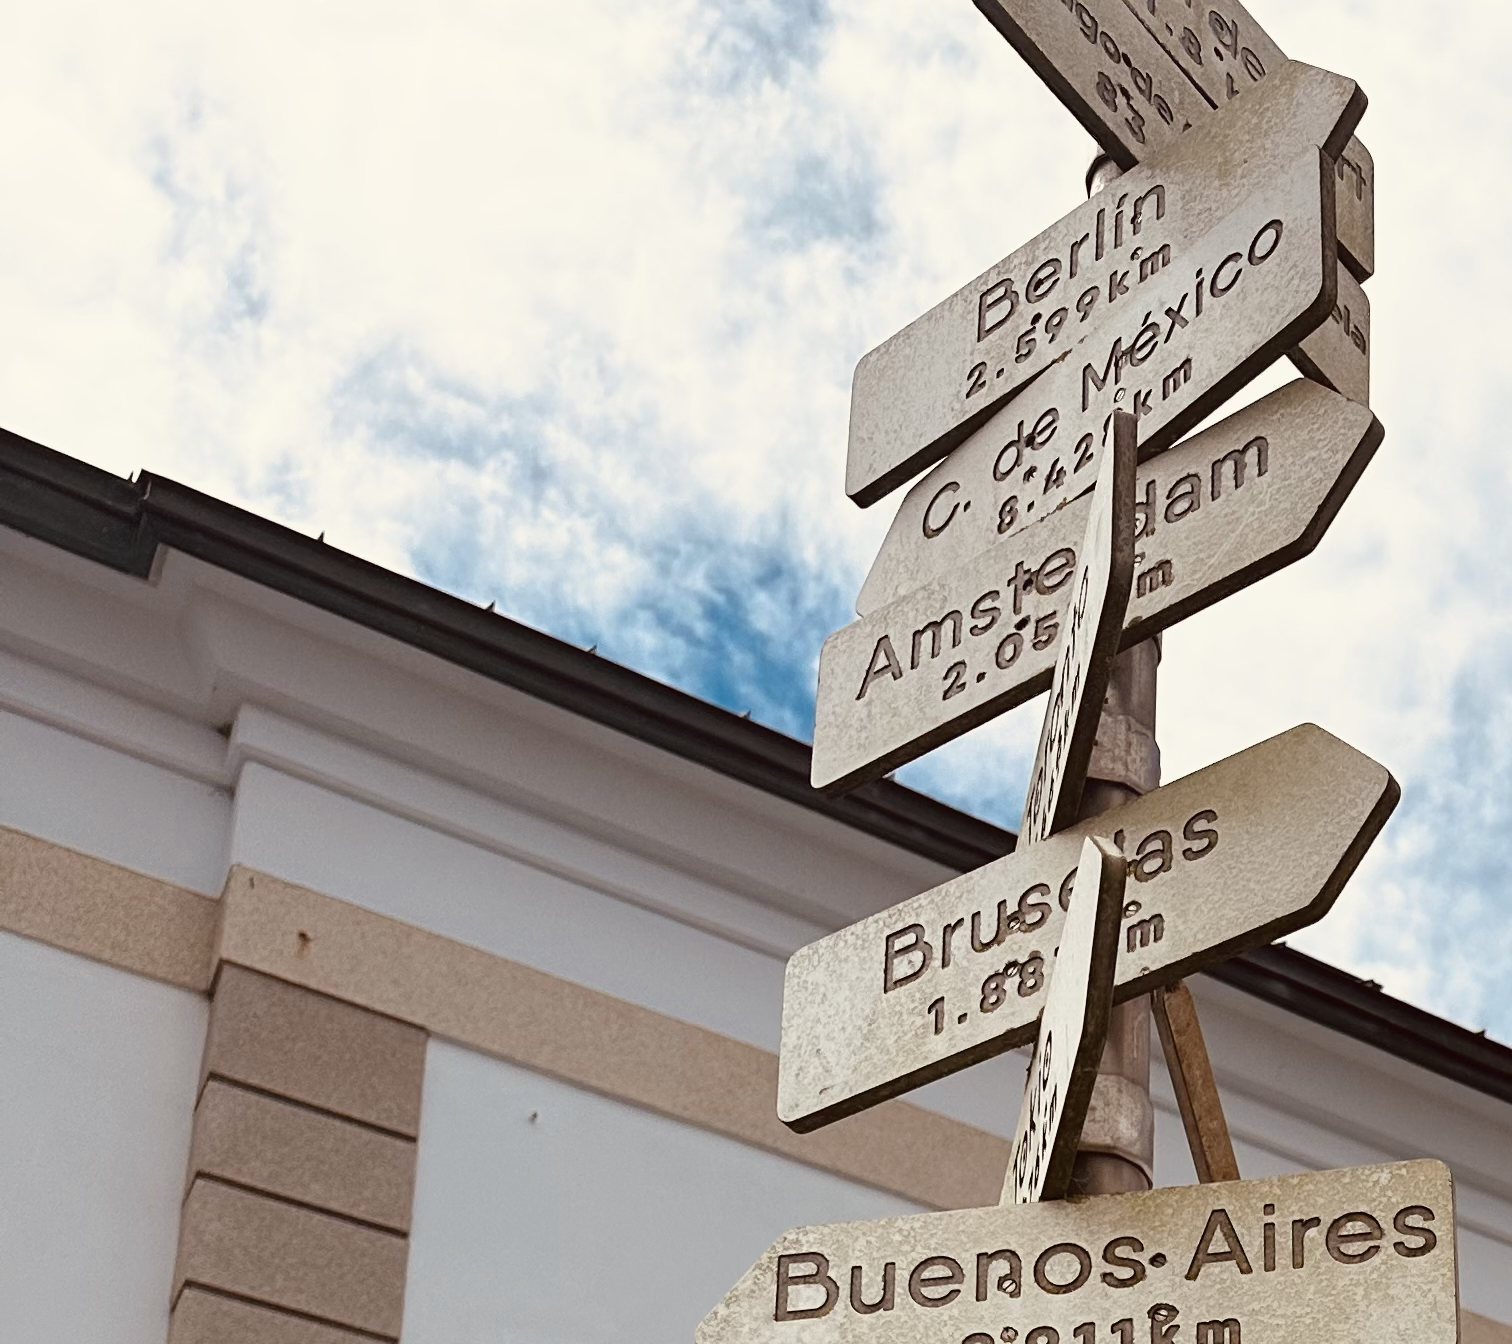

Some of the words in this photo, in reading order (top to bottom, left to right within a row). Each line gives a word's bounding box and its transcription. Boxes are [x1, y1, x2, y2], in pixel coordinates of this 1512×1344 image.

[921, 481, 971, 539] C.
[992, 407, 1060, 482] de
[1081, 218, 1284, 413] México
[965, 243, 1171, 399] 2.599km
[857, 434, 1270, 700] Amstedam
[773, 1236, 1146, 1321] Buenos
[1185, 1203, 1438, 1281] Aires
